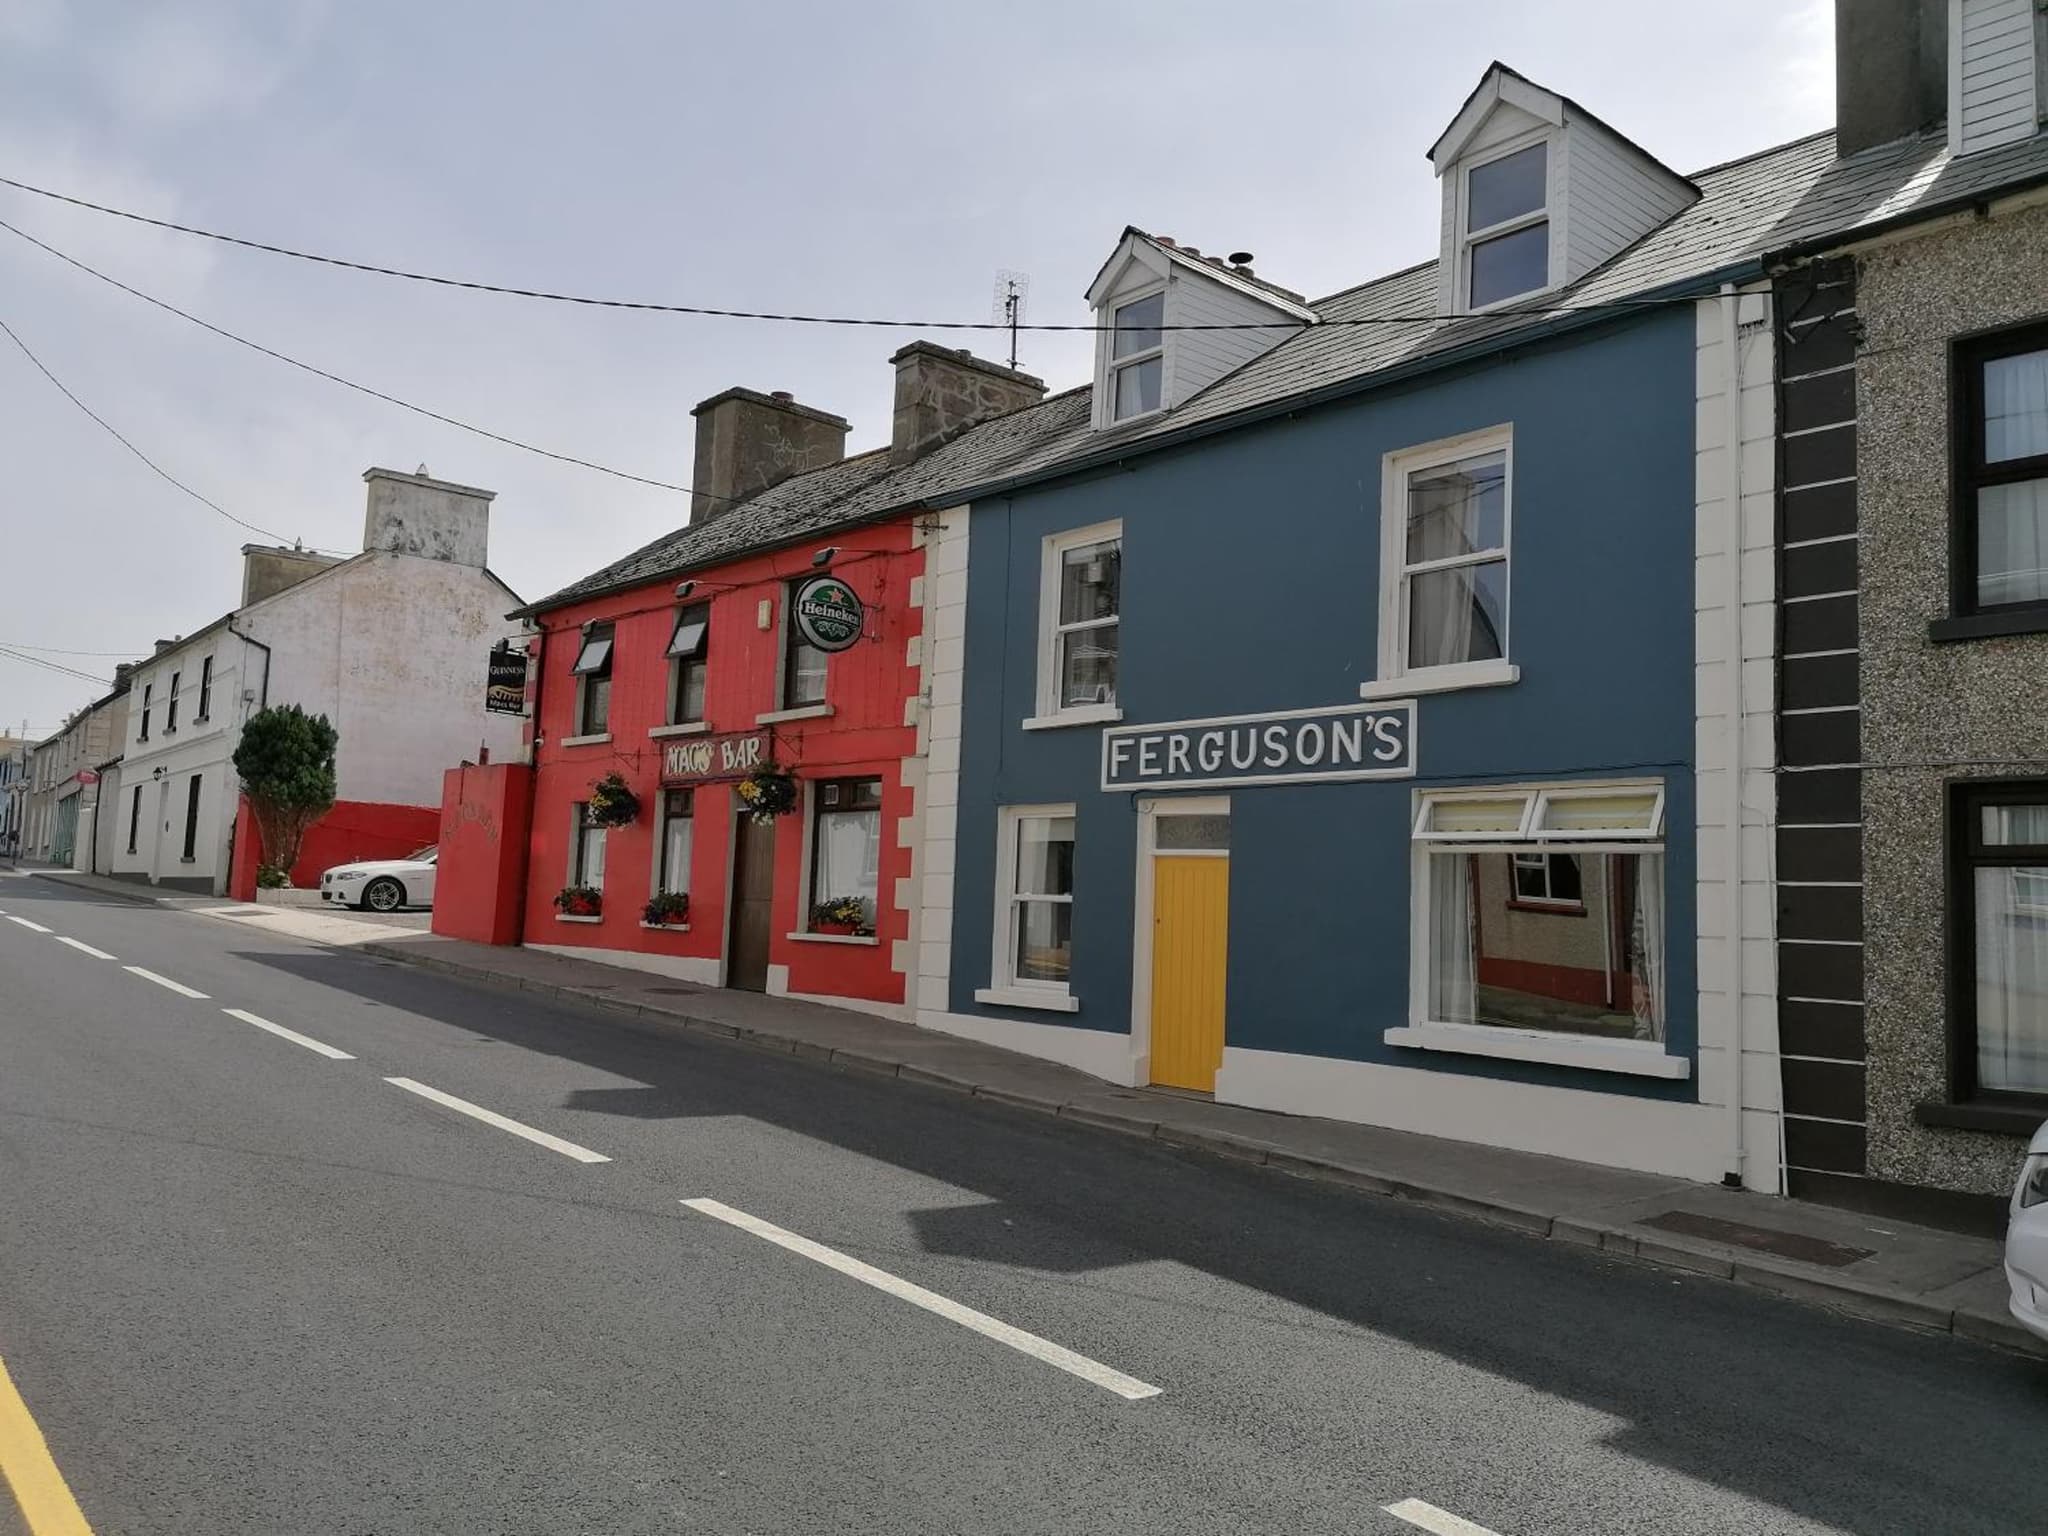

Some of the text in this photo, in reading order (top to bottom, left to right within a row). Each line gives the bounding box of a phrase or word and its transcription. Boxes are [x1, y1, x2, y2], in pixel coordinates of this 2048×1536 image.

[490, 665, 525, 675] GUINNESS
[721, 738, 760, 770] BAR
[1111, 715, 1402, 777] FERGUSON'S
